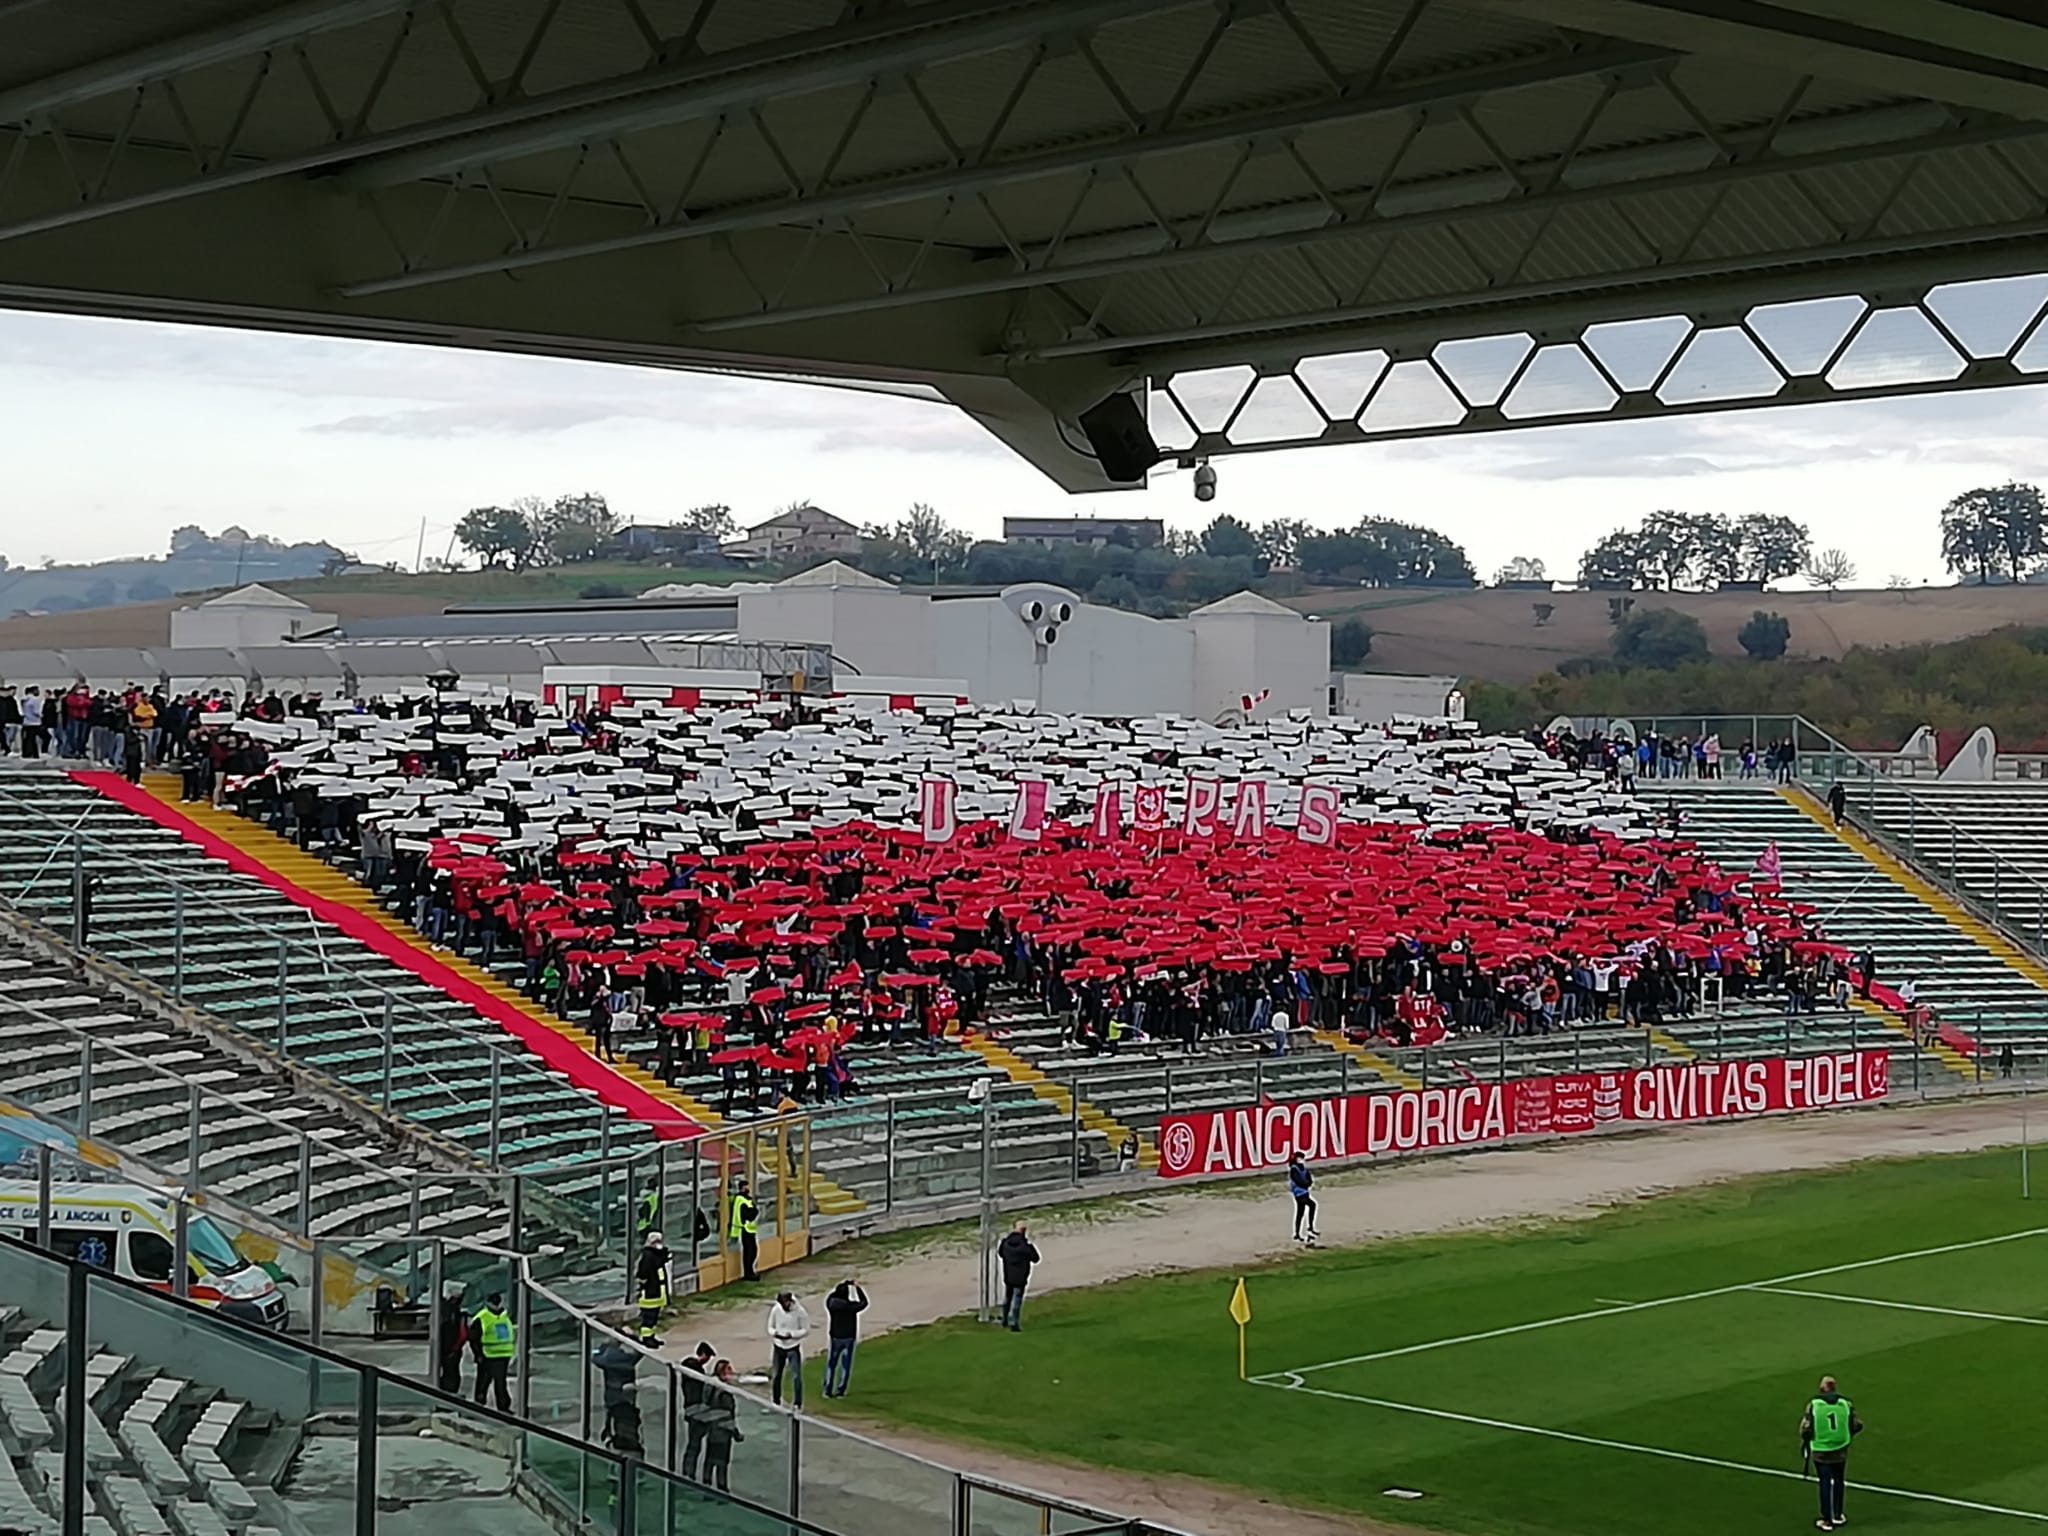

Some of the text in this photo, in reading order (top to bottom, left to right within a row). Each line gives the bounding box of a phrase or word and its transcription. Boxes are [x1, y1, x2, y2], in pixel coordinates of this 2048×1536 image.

[923, 779, 1341, 843] ULTRAS
[1634, 1062, 1767, 1119] CIVITAS
[1784, 1052, 1864, 1108] FIDEI
[1204, 1098, 1348, 1172] ANCON
[1367, 1085, 1506, 1153] DORICA
[66, 1210, 110, 1223] ANCONA
[1827, 1411, 1839, 1432] 1
